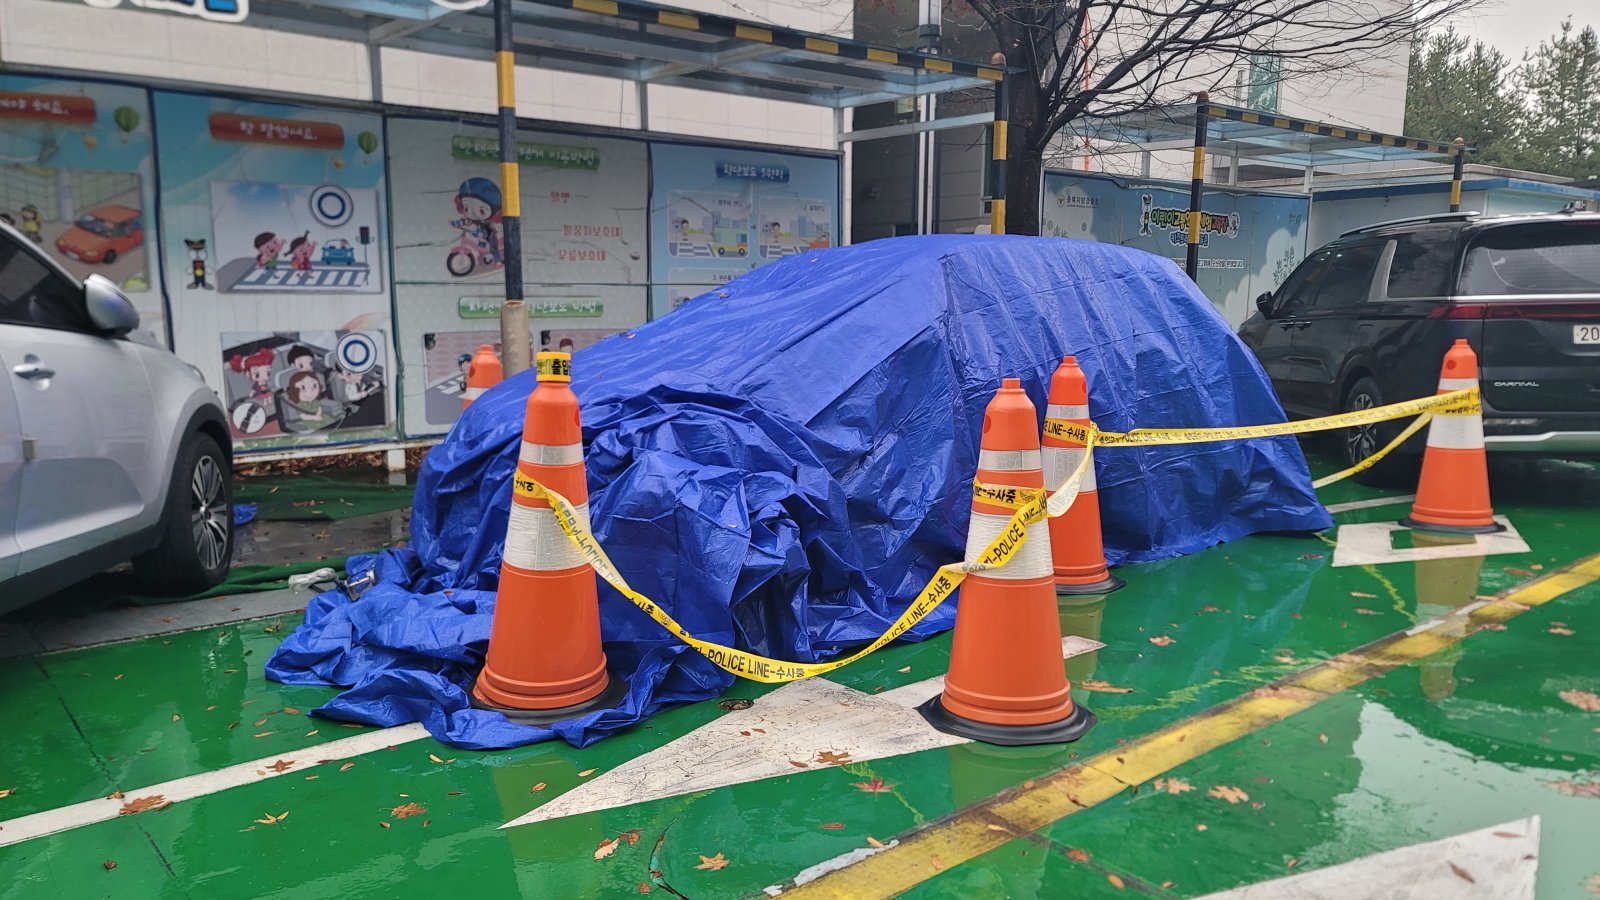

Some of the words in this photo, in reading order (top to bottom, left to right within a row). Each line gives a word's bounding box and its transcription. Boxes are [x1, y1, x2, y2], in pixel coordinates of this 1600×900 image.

[559, 249, 606, 262] 무릎보호대
[1580, 327, 1600, 341] 20
[906, 575, 952, 625] LINE-수사중
[747, 658, 805, 679] LINE-수사중
